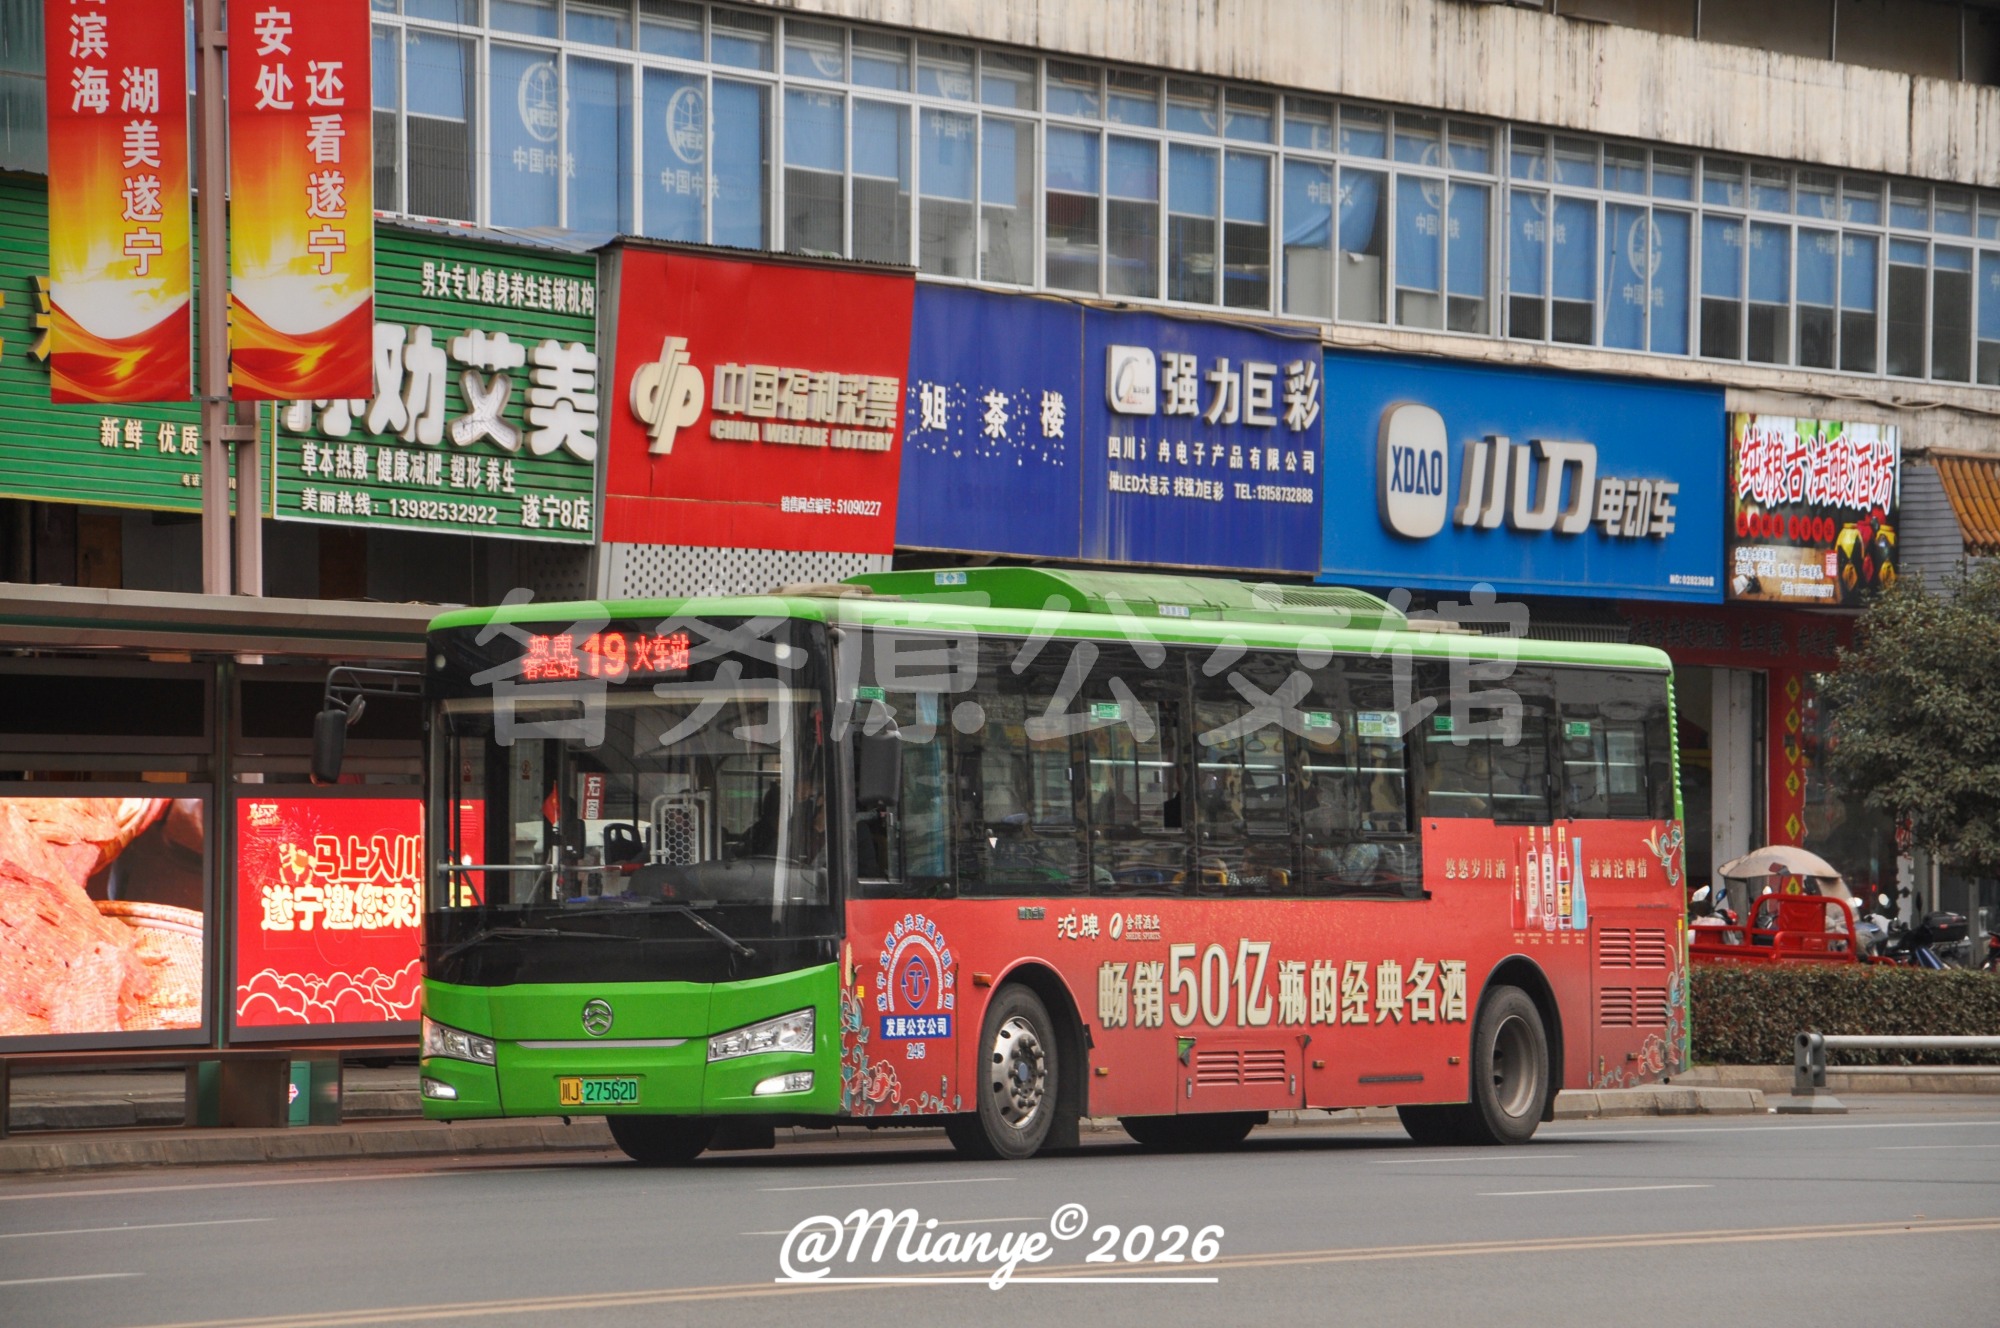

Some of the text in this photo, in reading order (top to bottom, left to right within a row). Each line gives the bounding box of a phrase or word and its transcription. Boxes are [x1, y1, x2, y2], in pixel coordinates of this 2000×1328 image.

[69, 0, 110, 114] 滨海
[254, 6, 294, 111] 安处
[120, 66, 163, 277] 湖美遂宁
[306, 60, 347, 275] 还看遂宁
[1415, 212, 1461, 239] 中国铁
[1523, 219, 1567, 245] 中国铁
[422, 261, 595, 315] 男女专业瘦身养生连锁机构
[712, 363, 899, 429] 中国福利彩票
[1161, 352, 1320, 432] 强力巨彩
[100, 416, 199, 455] 新鲜 优质
[710, 419, 894, 452] CHINA WELFARE LOTTERY
[301, 442, 368, 479] 草本热敷
[376, 447, 442, 487] 健康减肥
[1390, 444, 1443, 496] XDAO
[1738, 423, 1894, 515] 纯粮古法酿酒坊
[1174, 476, 1225, 501] 找强力巨彩
[1597, 476, 1679, 539] 电动车
[520, 494, 590, 531] 遂宁8店
[528, 633, 573, 657] 城南
[584, 632, 627, 677] 19
[632, 633, 690, 671] 火车站
[522, 656, 579, 680] 客运站
[1445, 857, 1507, 880] 悠悠岁月酒
[261, 882, 421, 931] 遂宁邀您来
[1057, 912, 1101, 940] 沱牌
[1125, 914, 1160, 931] 舍得酒业
[885, 1017, 947, 1037] 发展公交公司
[906, 1042, 926, 1060] 245
